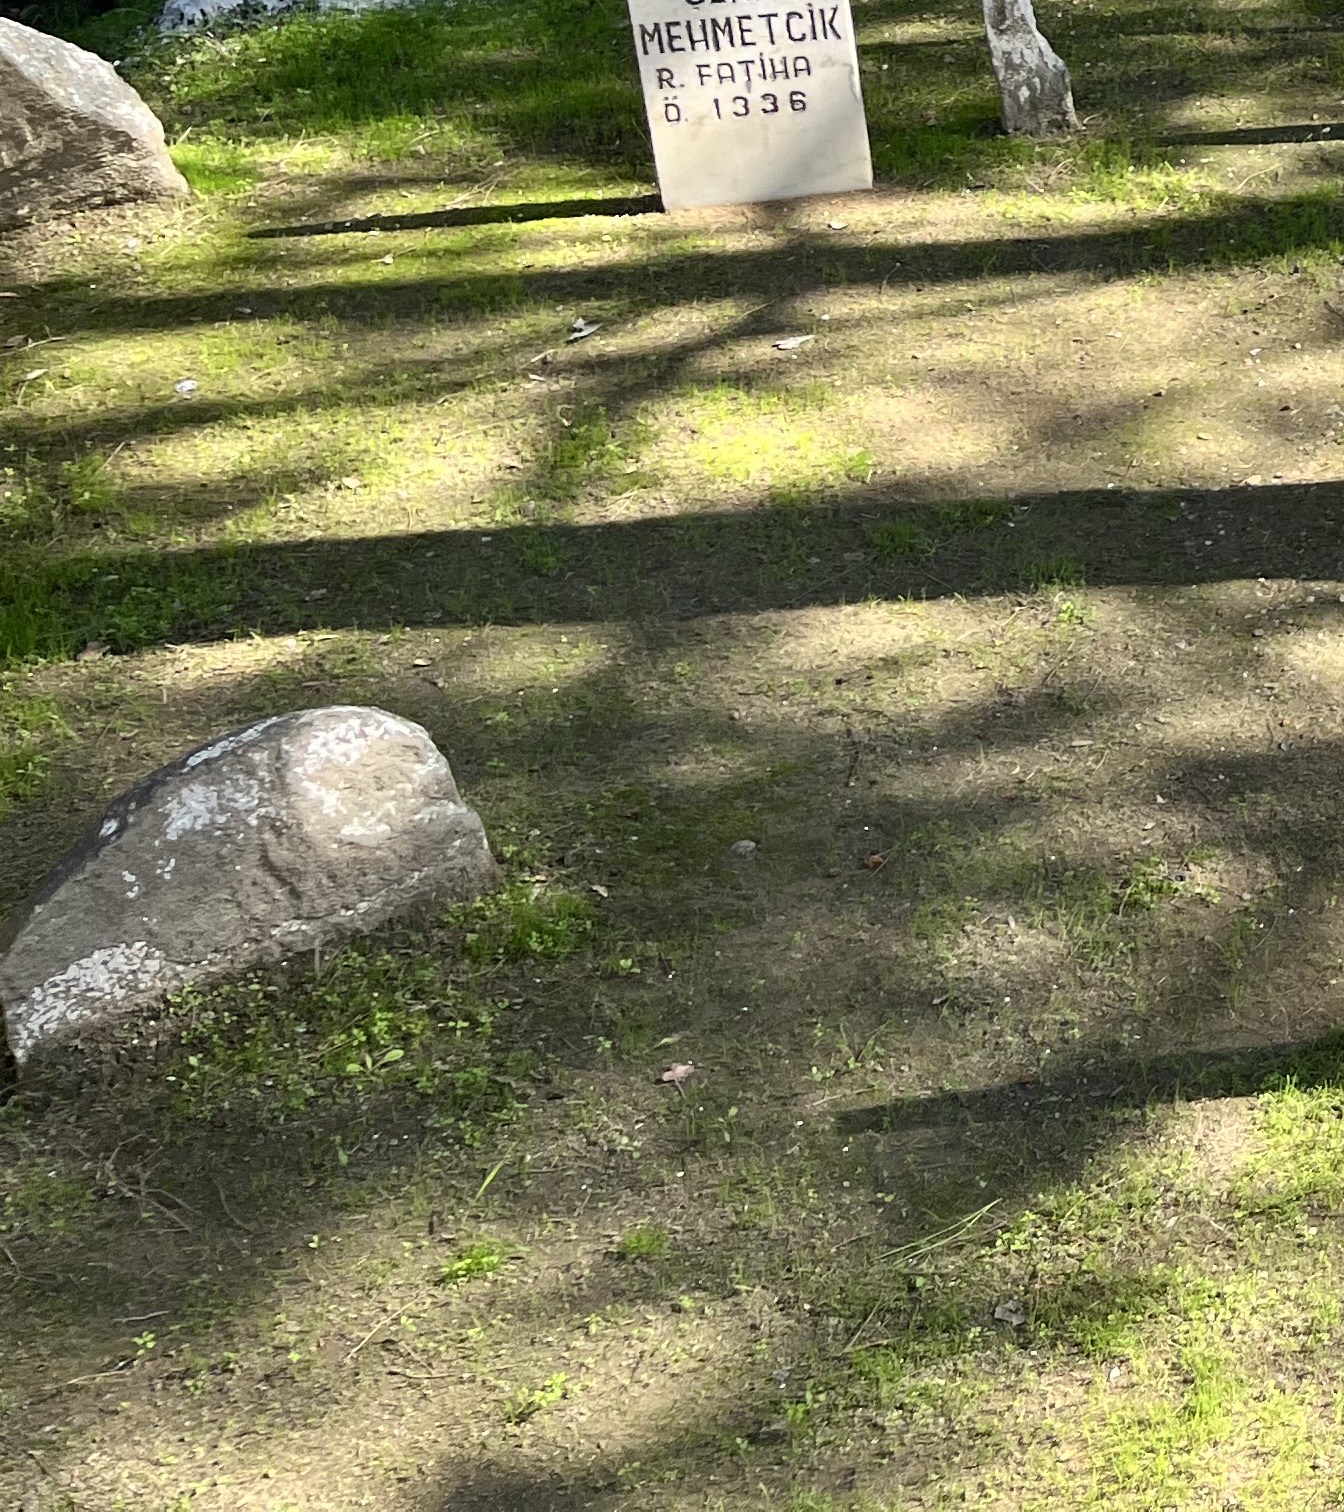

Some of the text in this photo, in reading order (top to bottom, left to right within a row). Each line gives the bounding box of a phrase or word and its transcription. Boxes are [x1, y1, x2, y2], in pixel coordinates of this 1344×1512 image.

[639, 2, 842, 56] MEHMETCİK
[656, 52, 811, 93] R. FATİHA
[664, 91, 807, 123] Ö. 1336
